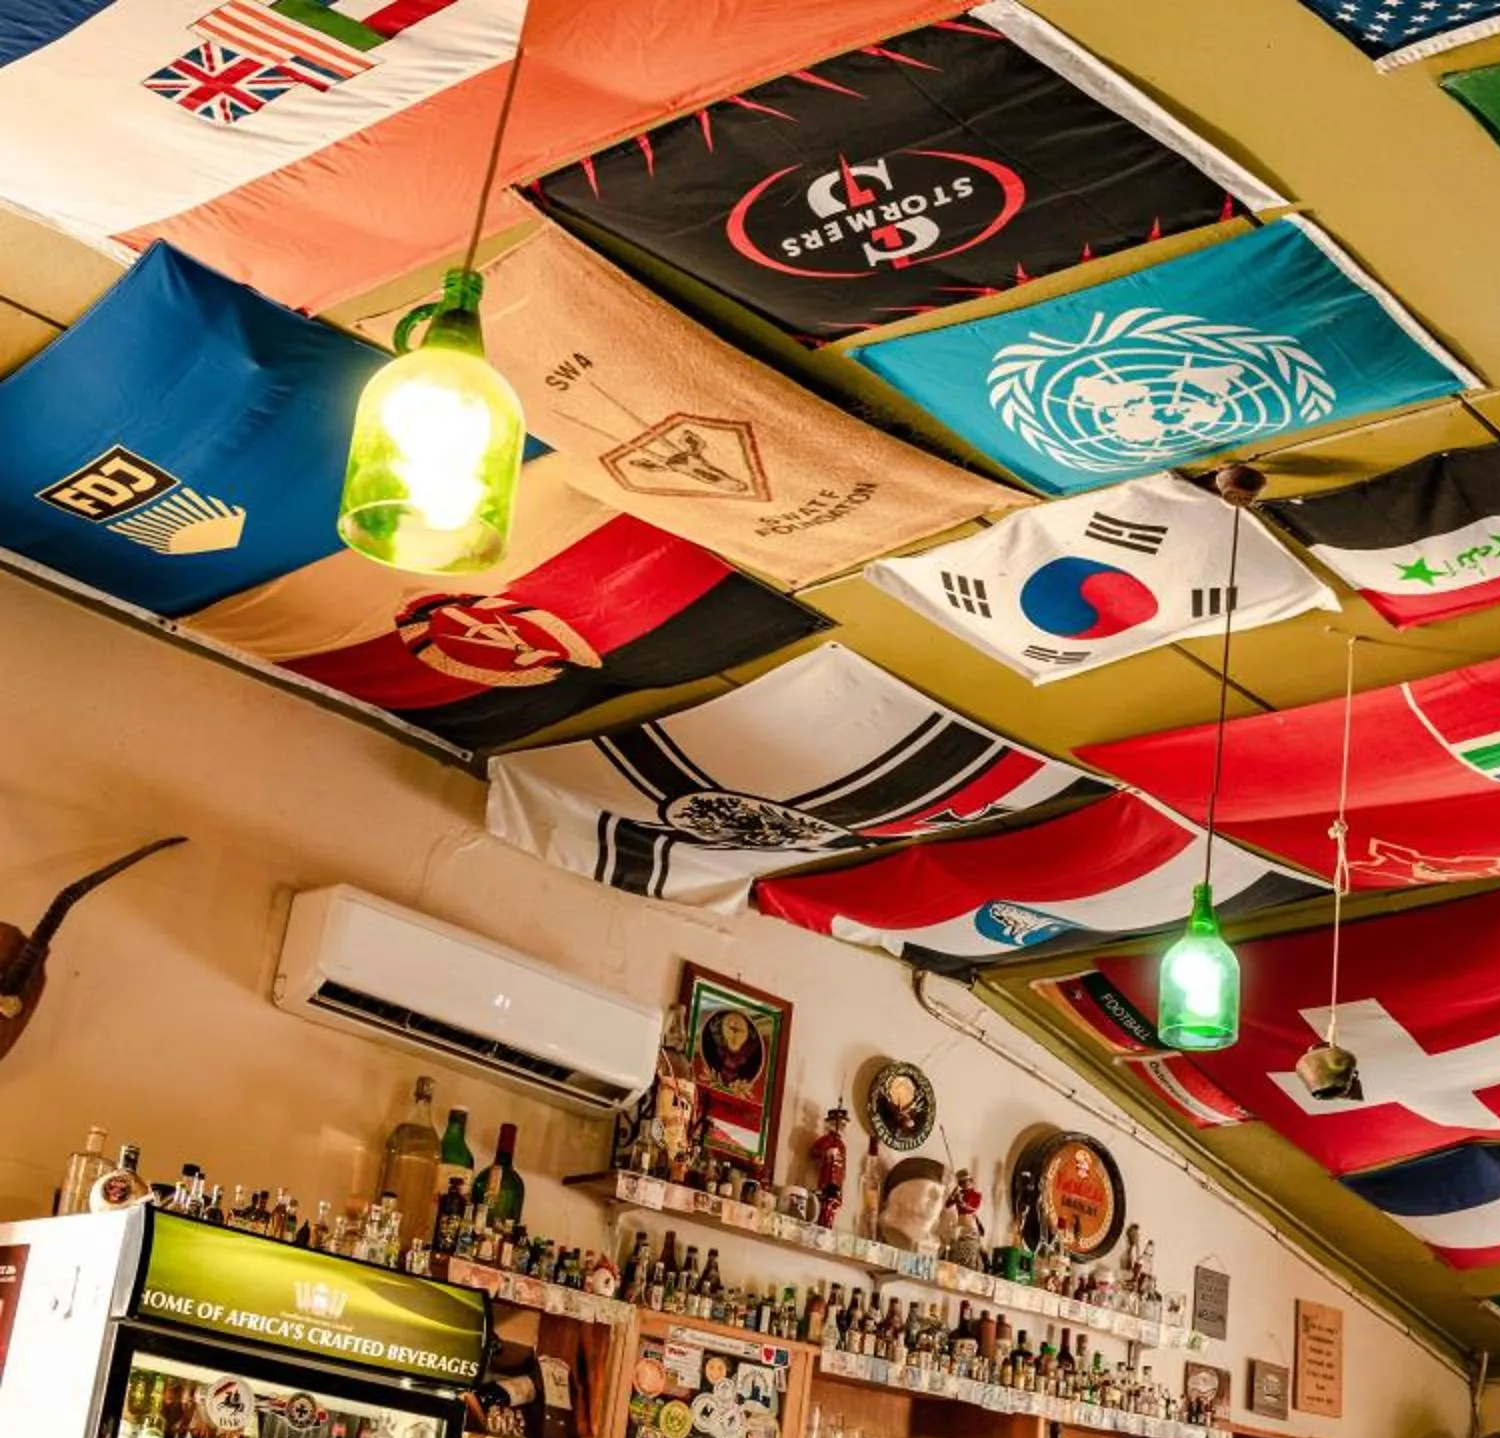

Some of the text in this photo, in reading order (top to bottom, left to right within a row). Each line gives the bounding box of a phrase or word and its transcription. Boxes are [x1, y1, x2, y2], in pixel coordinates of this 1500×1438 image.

[780, 176, 974, 257] STORMERS
[545, 350, 593, 392] SWA
[51, 456, 156, 516] FDJ
[1102, 992, 1151, 1042] FOOTBALL
[197, 1302, 224, 1321] OF
[224, 1309, 304, 1341] AFRICA'S
[307, 1327, 384, 1357] CRAFTED
[386, 1343, 480, 1378] BEVERAGES
